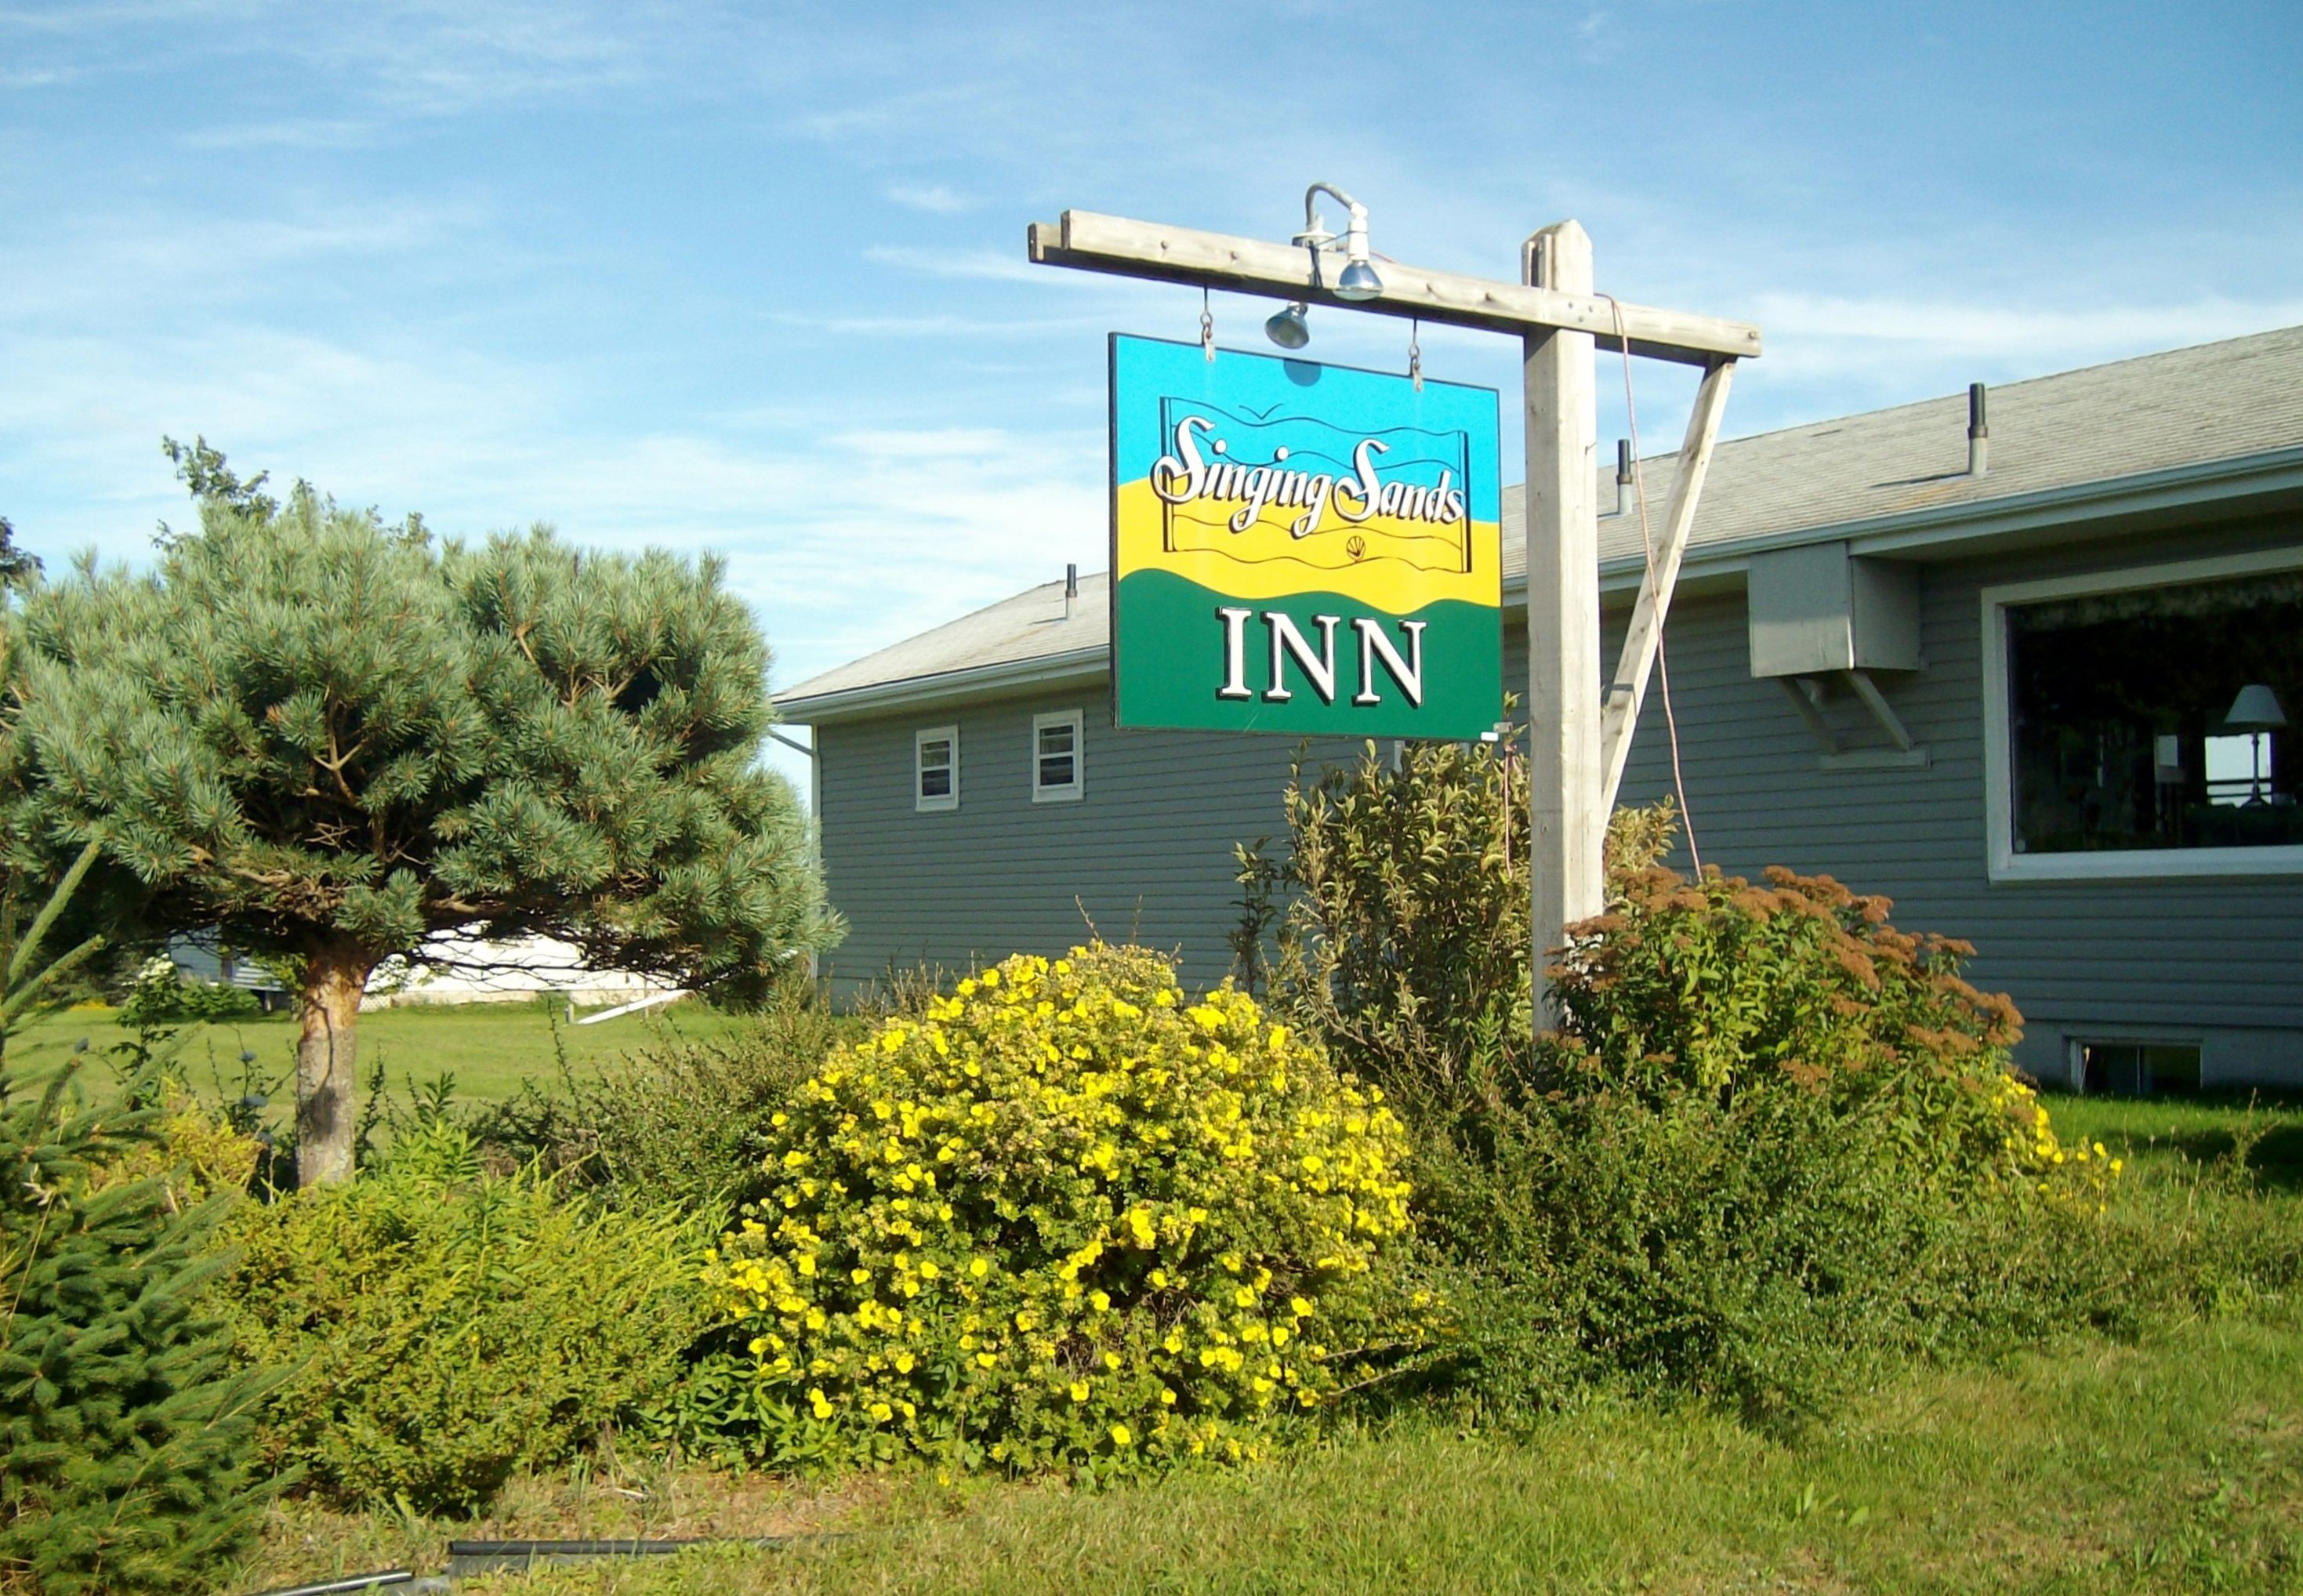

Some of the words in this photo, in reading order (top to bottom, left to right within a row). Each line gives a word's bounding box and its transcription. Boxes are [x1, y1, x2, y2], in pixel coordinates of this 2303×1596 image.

[1151, 415, 1333, 539] Singing
[1333, 437, 1466, 524] Sands
[1217, 607, 1427, 708] INN
